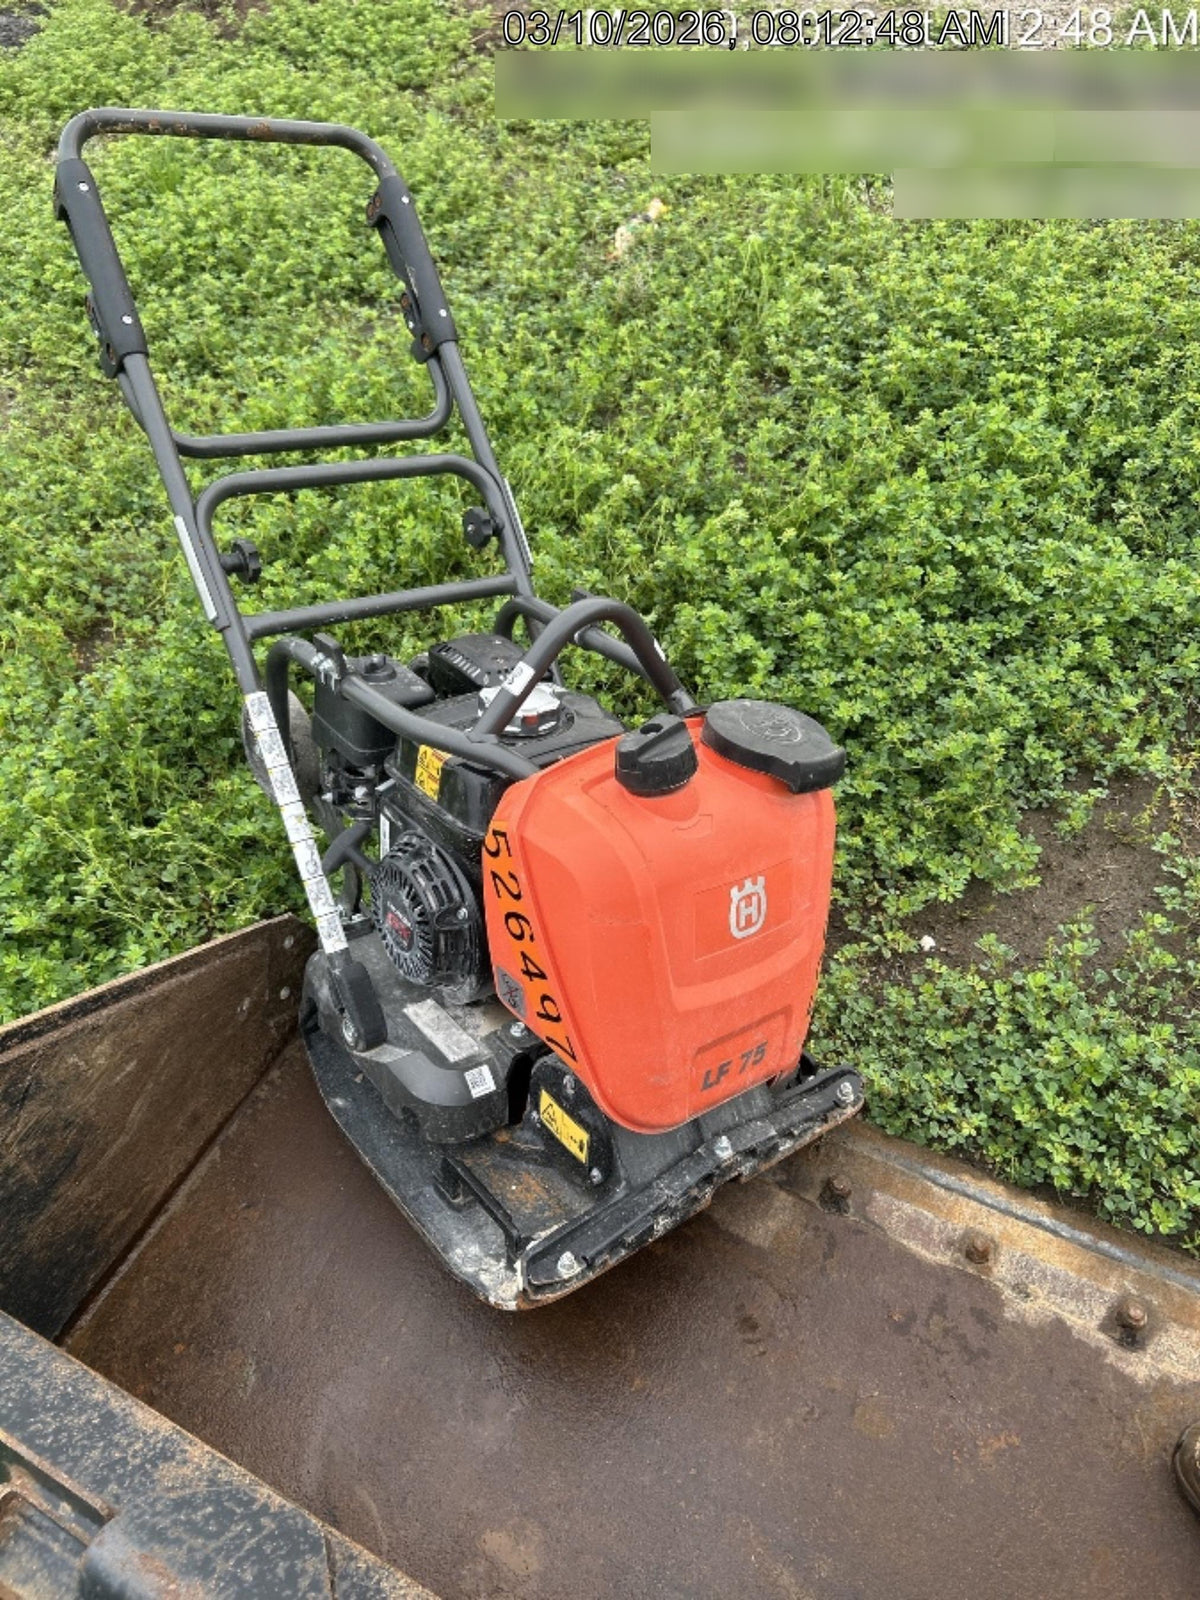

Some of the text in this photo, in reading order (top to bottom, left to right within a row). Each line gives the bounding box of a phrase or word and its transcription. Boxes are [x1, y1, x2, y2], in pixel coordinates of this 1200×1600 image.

[483, 829, 578, 1063] 526497
[700, 1041, 768, 1092] LF 75
